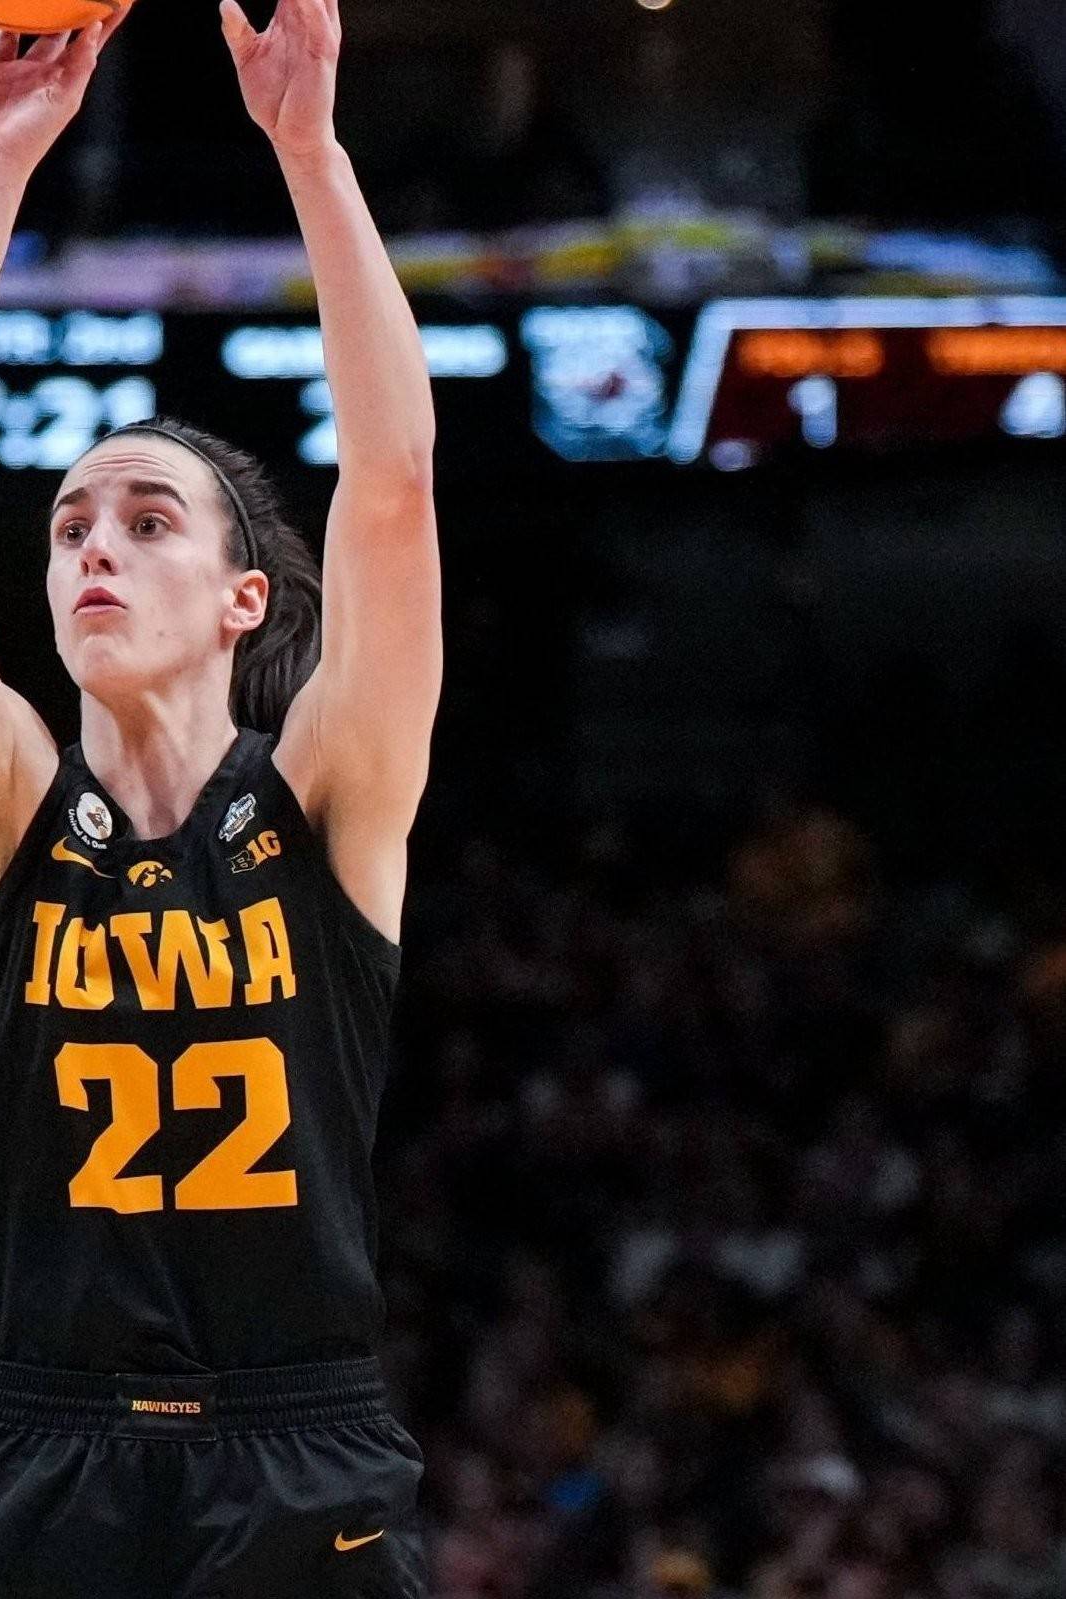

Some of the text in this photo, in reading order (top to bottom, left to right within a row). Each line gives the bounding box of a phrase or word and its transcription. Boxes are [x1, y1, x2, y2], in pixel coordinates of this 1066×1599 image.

[25, 897, 296, 1010] IOWA
[54, 1037, 297, 1214] 22
[131, 1400, 201, 1414] HAWKEYES
